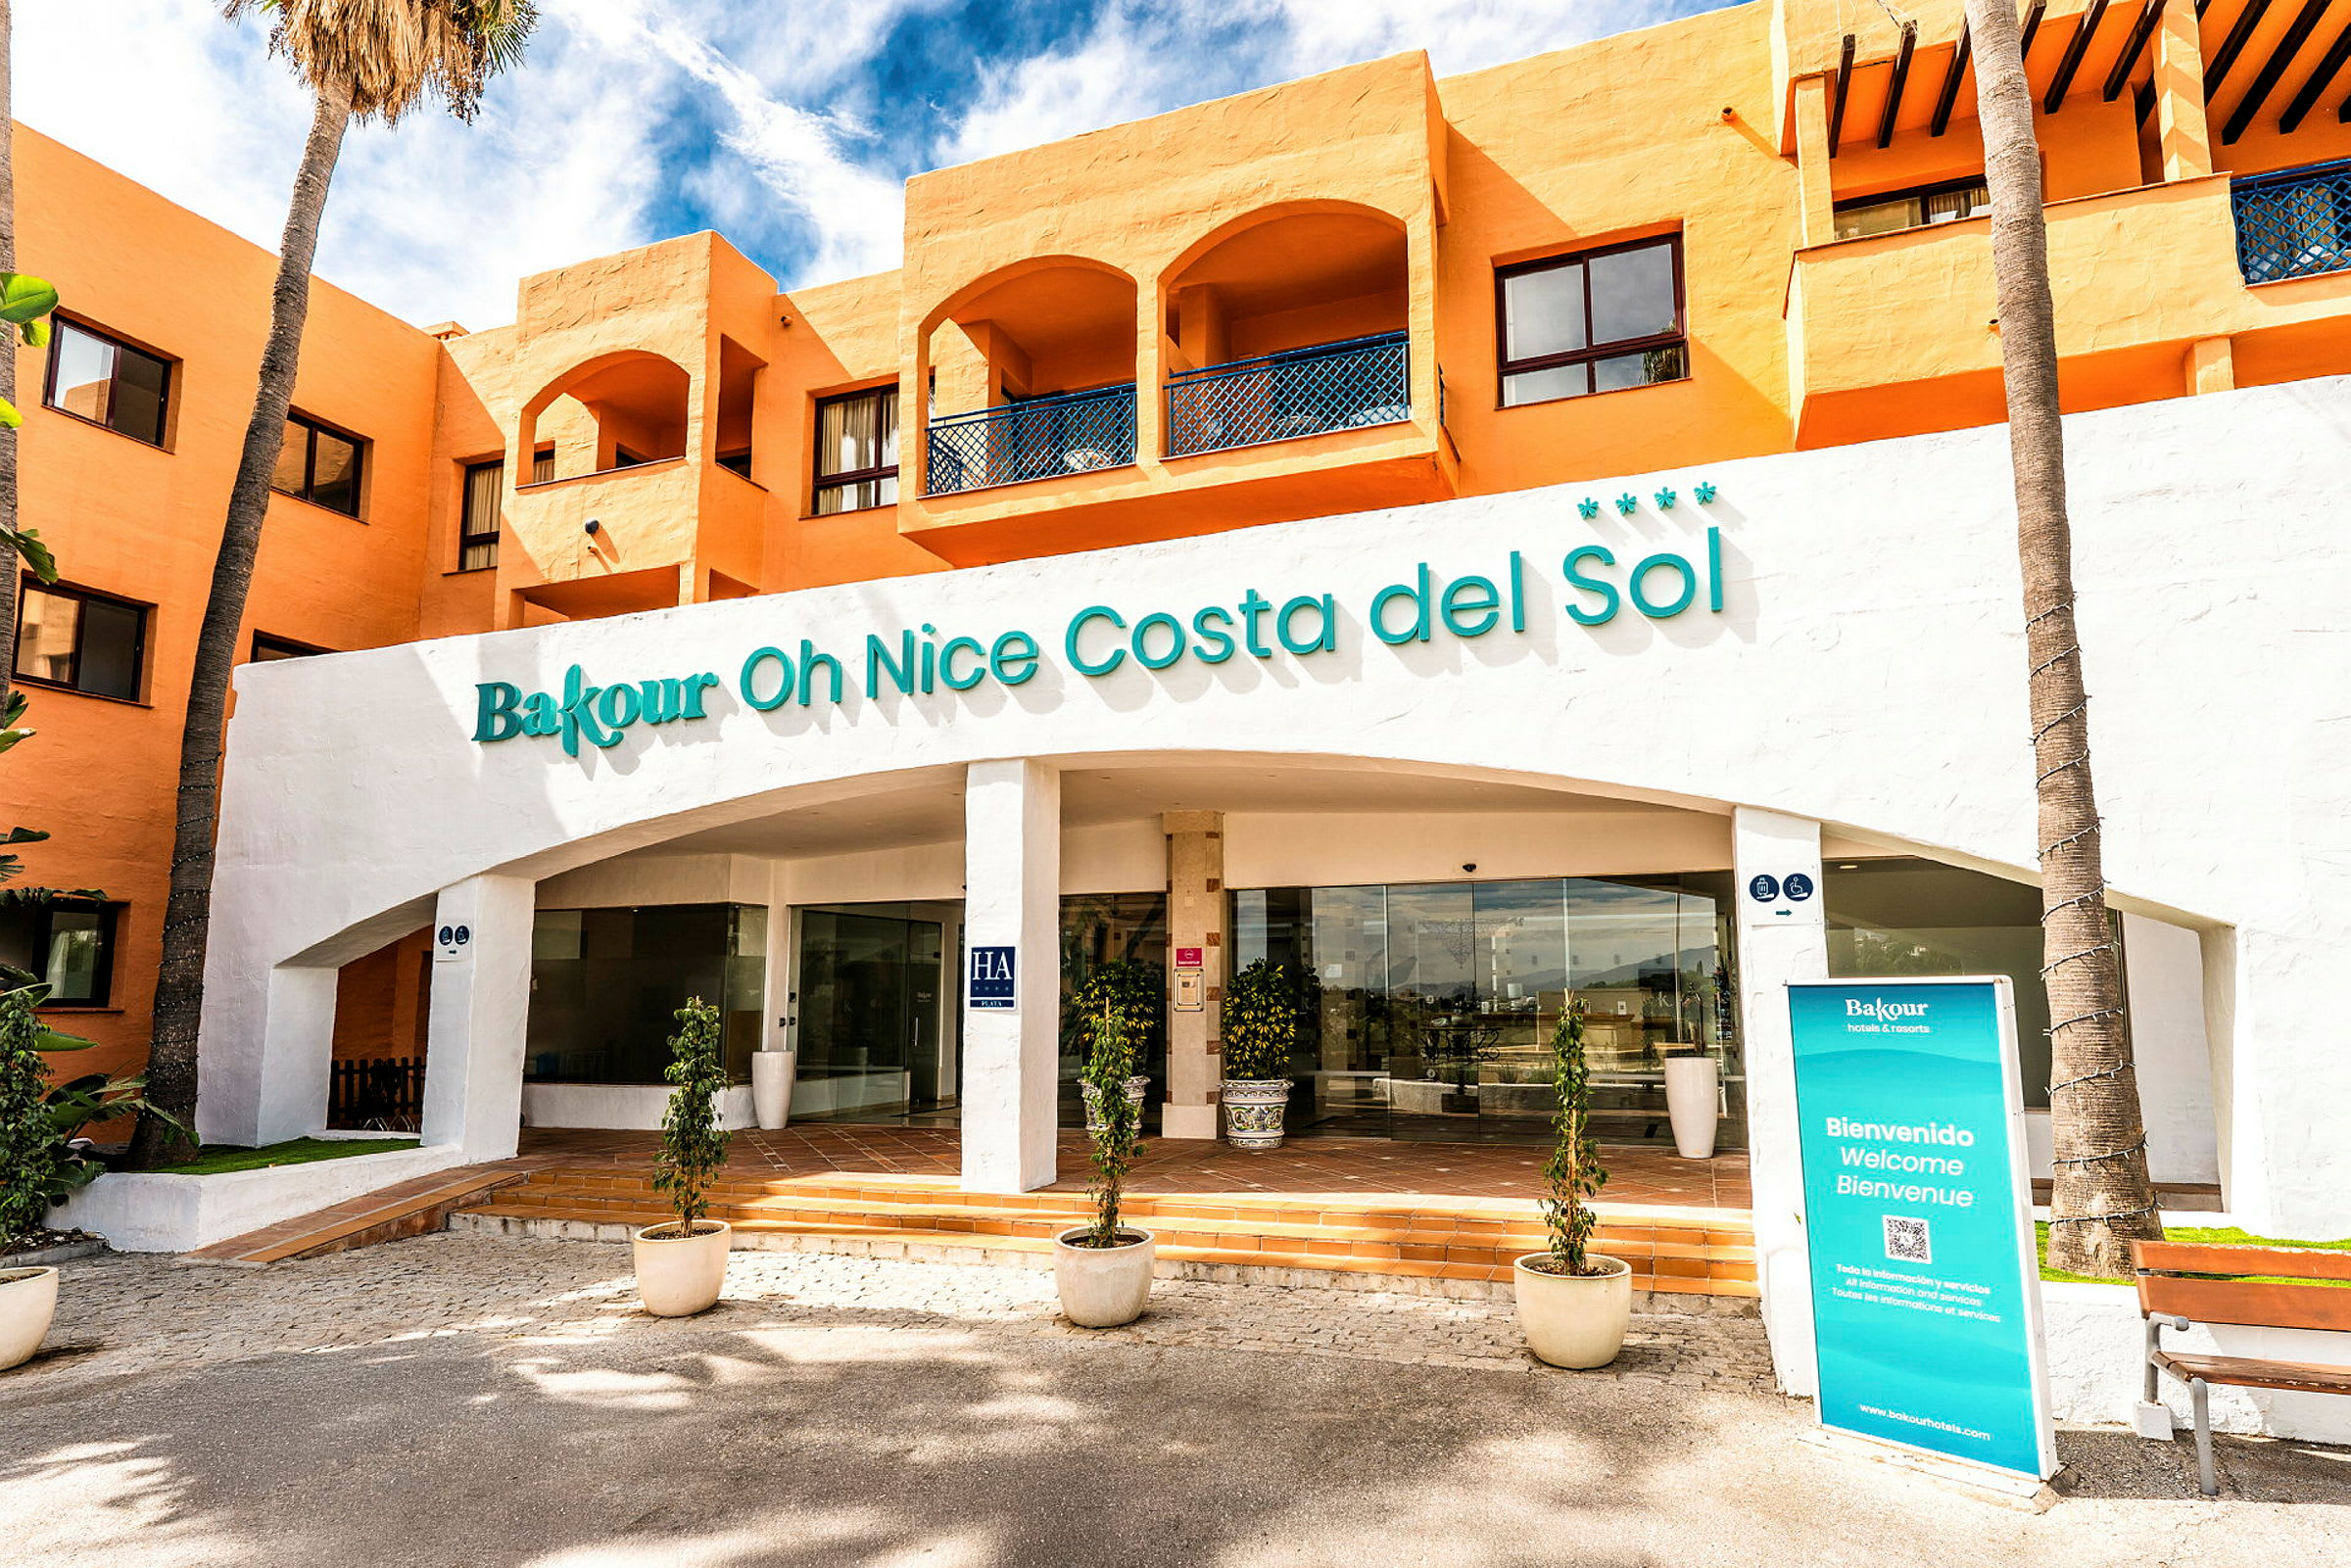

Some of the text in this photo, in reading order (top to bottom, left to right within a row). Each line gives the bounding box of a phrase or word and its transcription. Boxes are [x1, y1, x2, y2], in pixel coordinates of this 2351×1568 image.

[471, 526, 1723, 757] Bakour Oh Nice Costa del Sol
[972, 951, 1013, 980] HA
[1845, 997, 1929, 1022] Bakour
[1847, 1023, 1931, 1033] hotels & resorts
[1826, 1117, 1975, 1147] Bienvenido
[1841, 1146, 1964, 1175] Welcome
[1837, 1174, 1974, 1207] Bienvenue
[1836, 1263, 1860, 1275] Toda
[1873, 1268, 1934, 1287] información
[1943, 1280, 1991, 1295] servicios
[1846, 1277, 1858, 1286] All
[1917, 1289, 1938, 1300] and
[1940, 1293, 1983, 1307] services
[1832, 1287, 1862, 1301] Toutes
[1864, 1292, 1878, 1302] les
[1880, 1296, 1943, 1314] informations
[1957, 1307, 2001, 1323] services
[1860, 1404, 1991, 1441] www.bakourhotels.com
